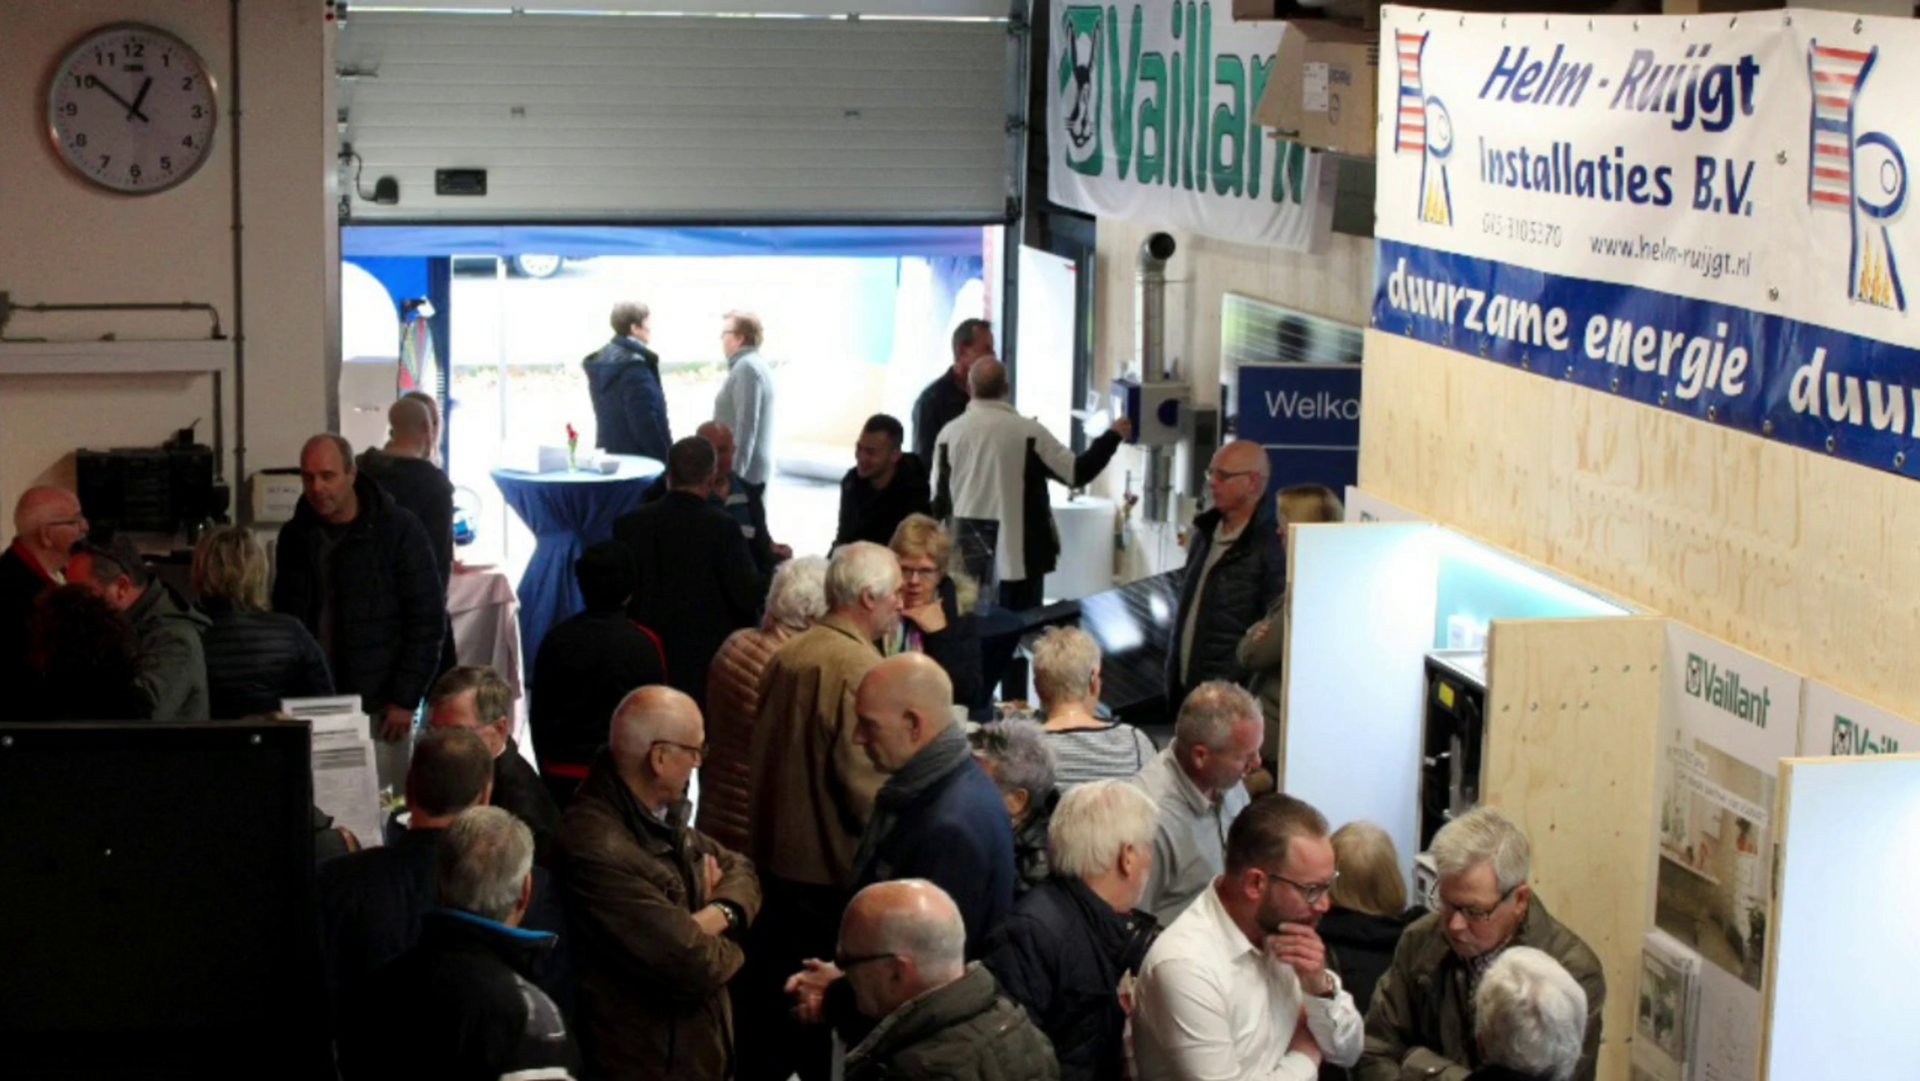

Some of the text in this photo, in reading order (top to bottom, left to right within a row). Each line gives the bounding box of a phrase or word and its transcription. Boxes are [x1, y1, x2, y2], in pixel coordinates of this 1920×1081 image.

[123, 44, 144, 58] 12
[96, 52, 115, 66] 11
[162, 54, 169, 67] 1
[74, 74, 96, 89] 10
[1478, 44, 1593, 107] Helm
[182, 77, 193, 91] 2
[65, 102, 78, 117] 9
[191, 105, 202, 119] 3
[75, 133, 87, 147] 8
[182, 135, 193, 148] 4
[100, 155, 111, 168] 7
[160, 156, 172, 171] 5
[130, 164, 141, 178] 6
[1478, 136, 1756, 217] Installaties B.V.
[1590, 234, 1752, 279] www.helm-ruijgt.nl
[1388, 258, 1749, 400] duurzame energie
[1264, 390, 1361, 420] Welko
[1704, 659, 1771, 729] Vaillant
